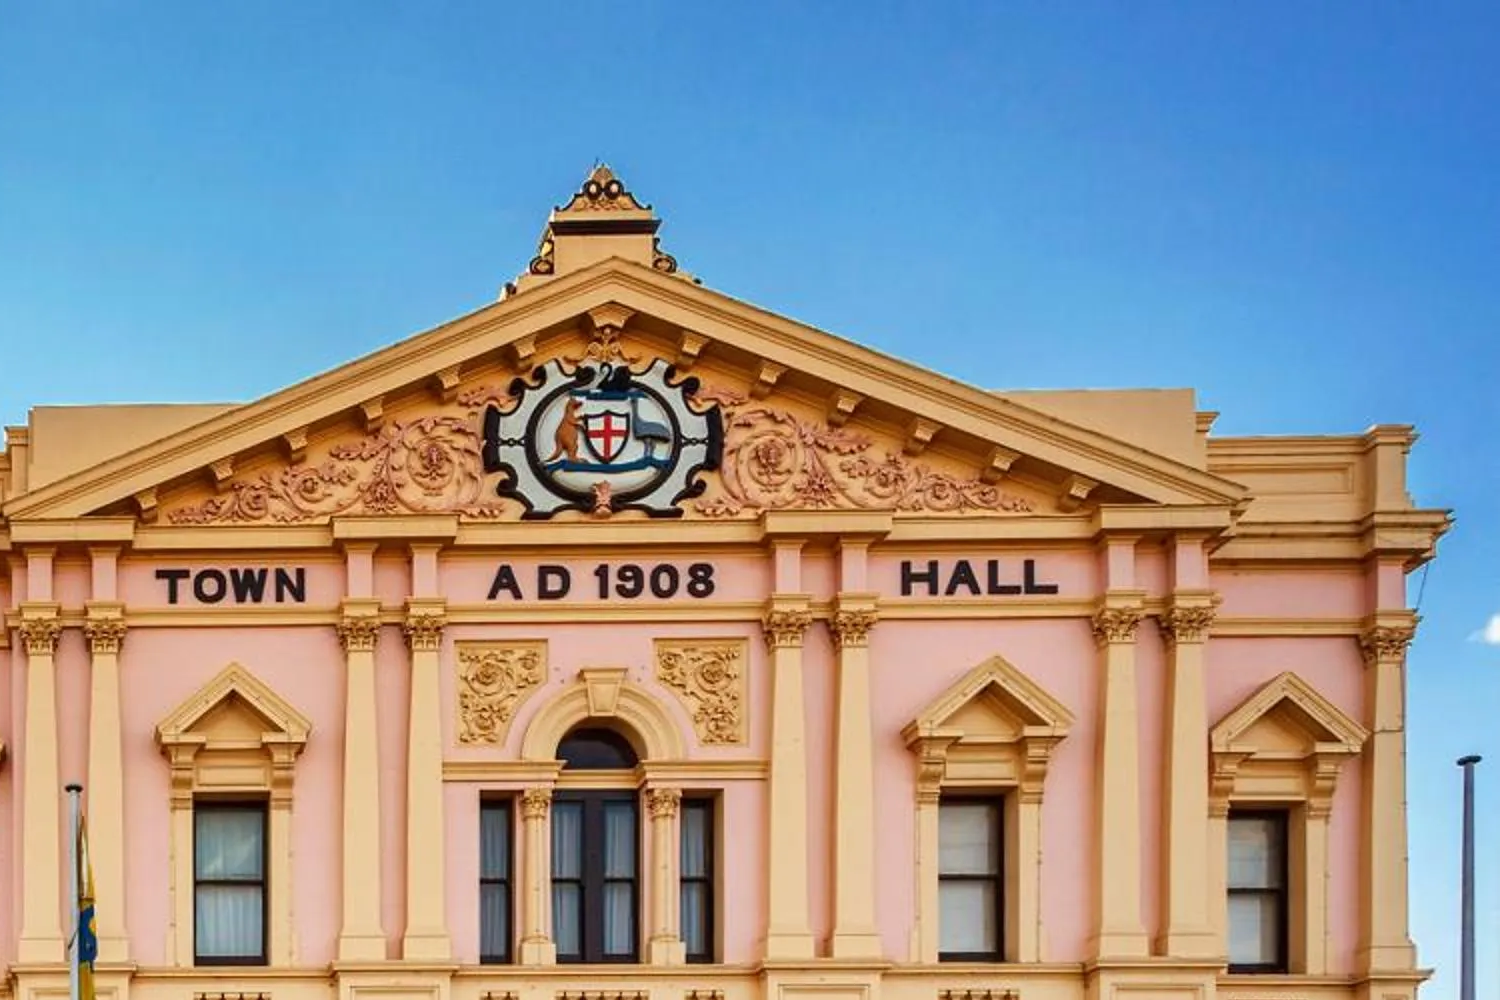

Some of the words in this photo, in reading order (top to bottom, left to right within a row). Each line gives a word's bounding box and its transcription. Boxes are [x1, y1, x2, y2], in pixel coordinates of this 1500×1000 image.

[155, 567, 306, 604] TOWN
[593, 563, 715, 599] 1908
[900, 559, 1059, 596] HALL
